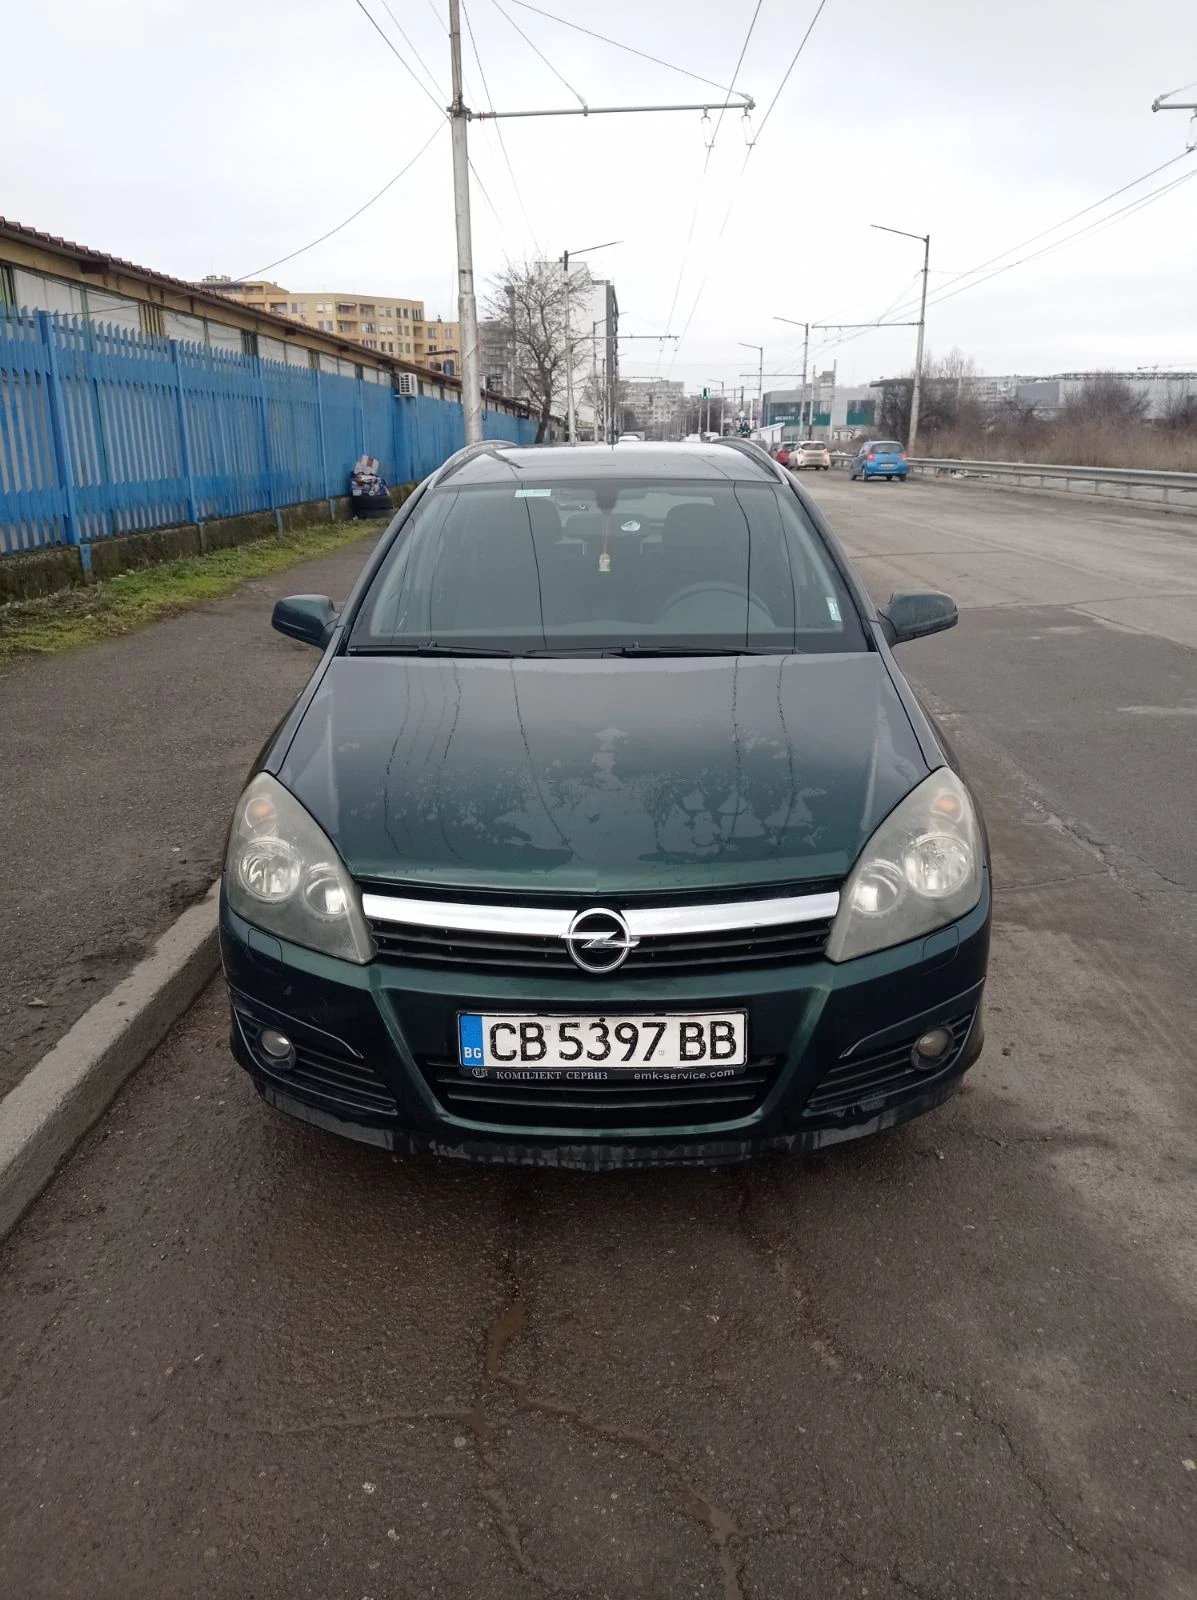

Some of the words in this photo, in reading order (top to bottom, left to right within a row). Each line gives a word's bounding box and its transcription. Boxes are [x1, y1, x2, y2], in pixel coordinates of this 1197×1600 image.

[490, 1022, 547, 1061] CB
[558, 1022, 667, 1061] 5397
[679, 1020, 737, 1061] BB
[463, 1047, 482, 1059] BG
[496, 1071, 562, 1080] КОМПЛЕКТ
[566, 1071, 608, 1080] СЕРВИЗ
[633, 1068, 735, 1080] emk-service.com
